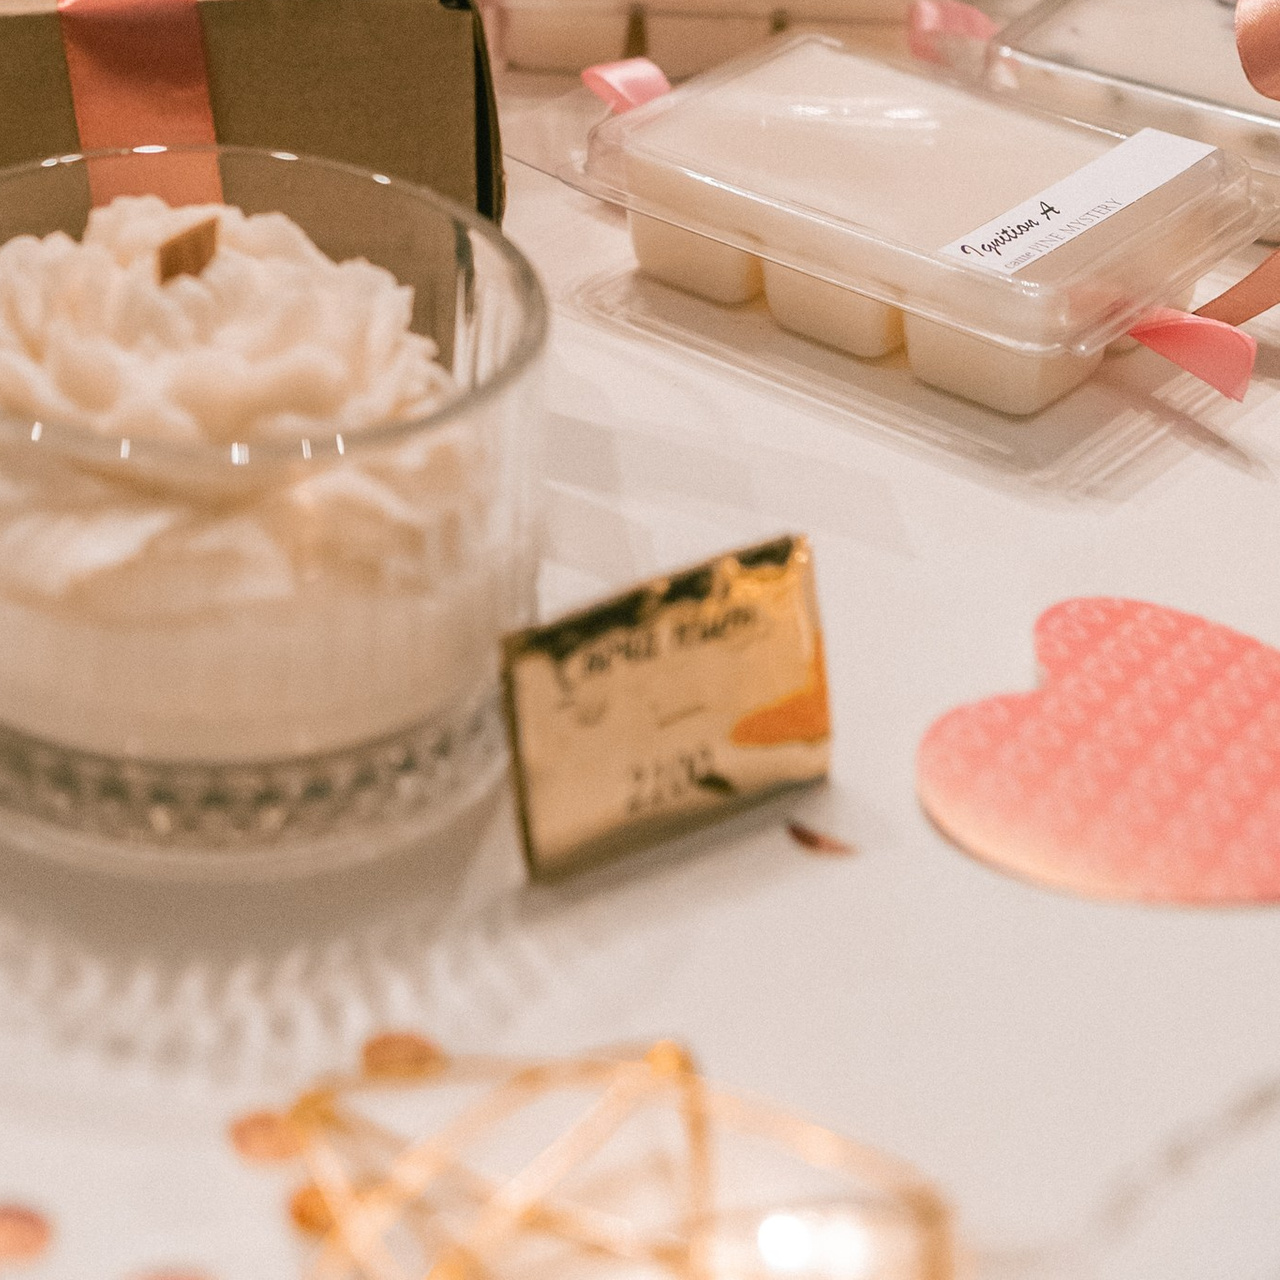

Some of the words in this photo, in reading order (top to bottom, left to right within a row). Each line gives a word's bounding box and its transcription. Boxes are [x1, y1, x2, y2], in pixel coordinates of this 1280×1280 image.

[960, 218, 1040, 257] Ignition
[1039, 200, 1061, 221] A
[1028, 231, 1066, 253] PINE
[1059, 197, 1123, 235] MYSTERY
